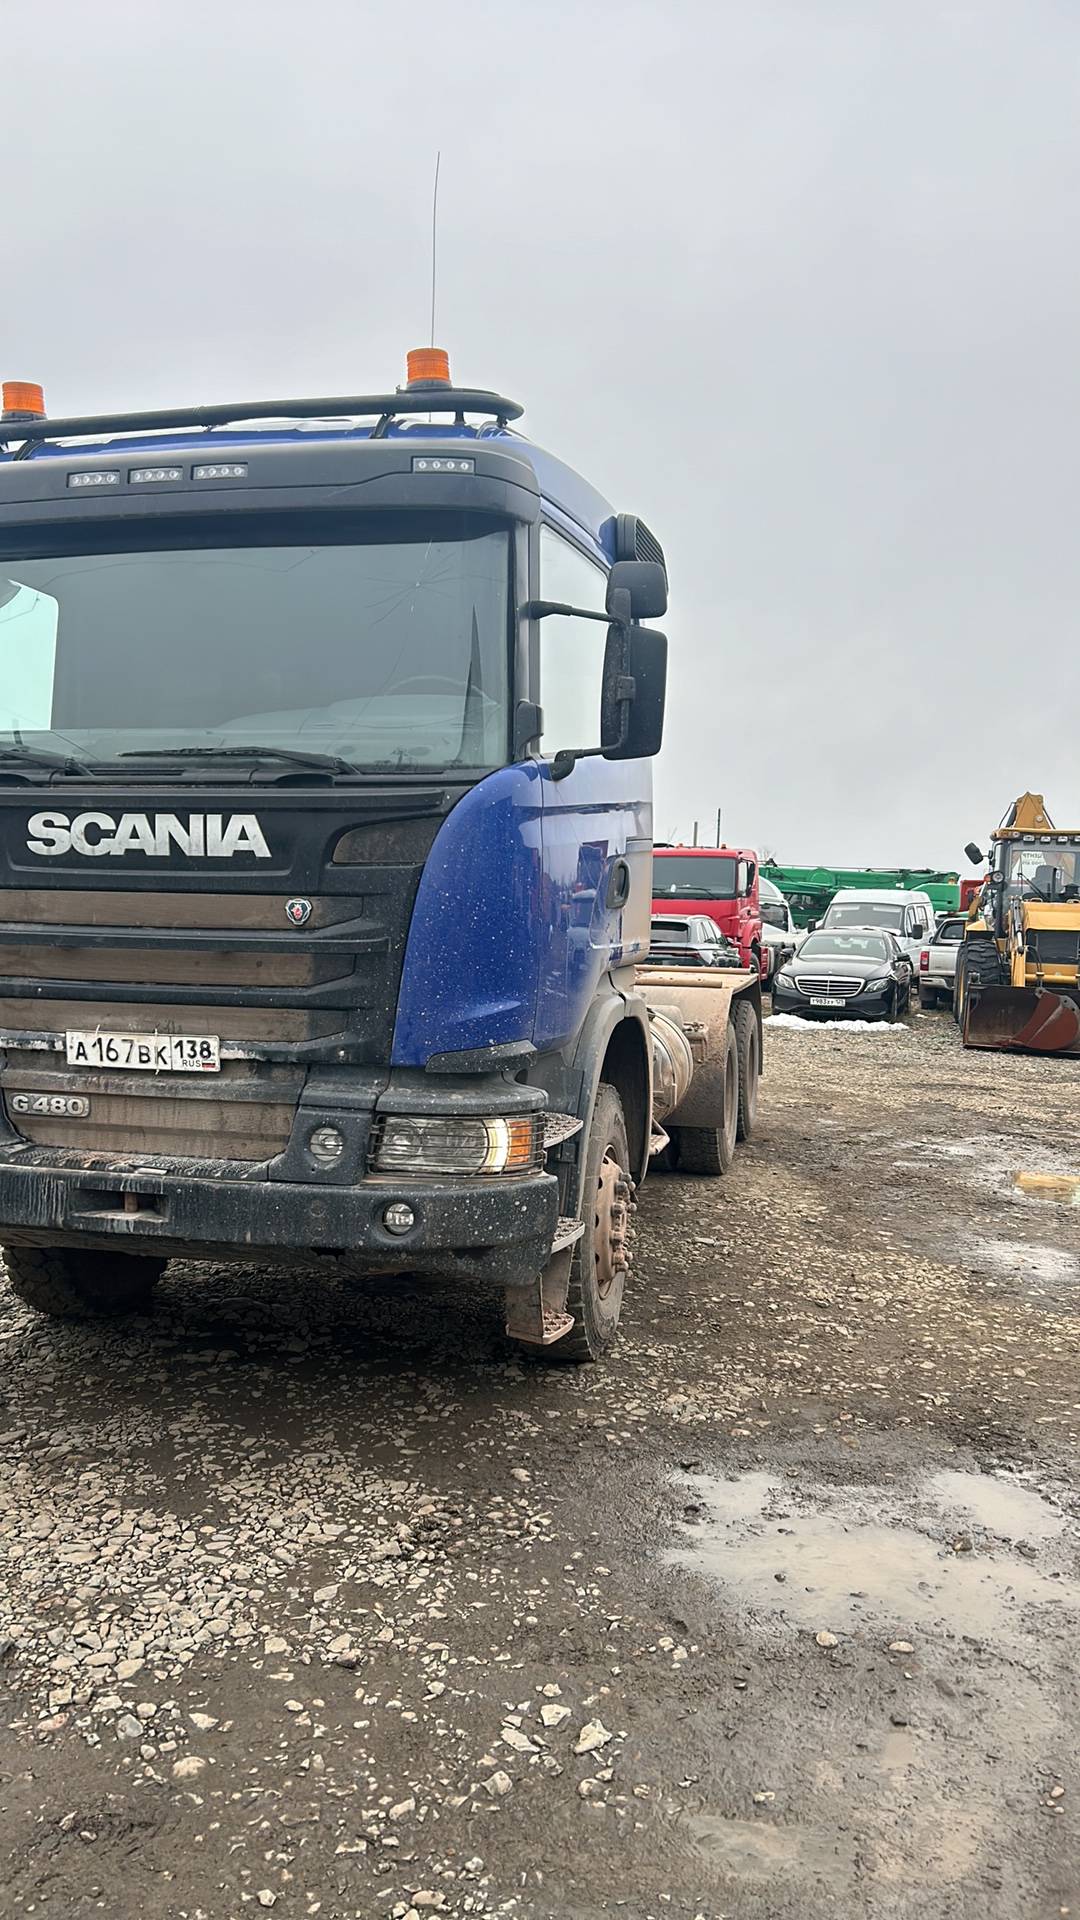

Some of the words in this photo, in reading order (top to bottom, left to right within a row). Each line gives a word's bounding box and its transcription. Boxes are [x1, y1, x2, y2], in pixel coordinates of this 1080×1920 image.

[26, 811, 272, 857] SCANIA
[174, 1040, 211, 1059] 138
[182, 1059, 201, 1067] RUS
